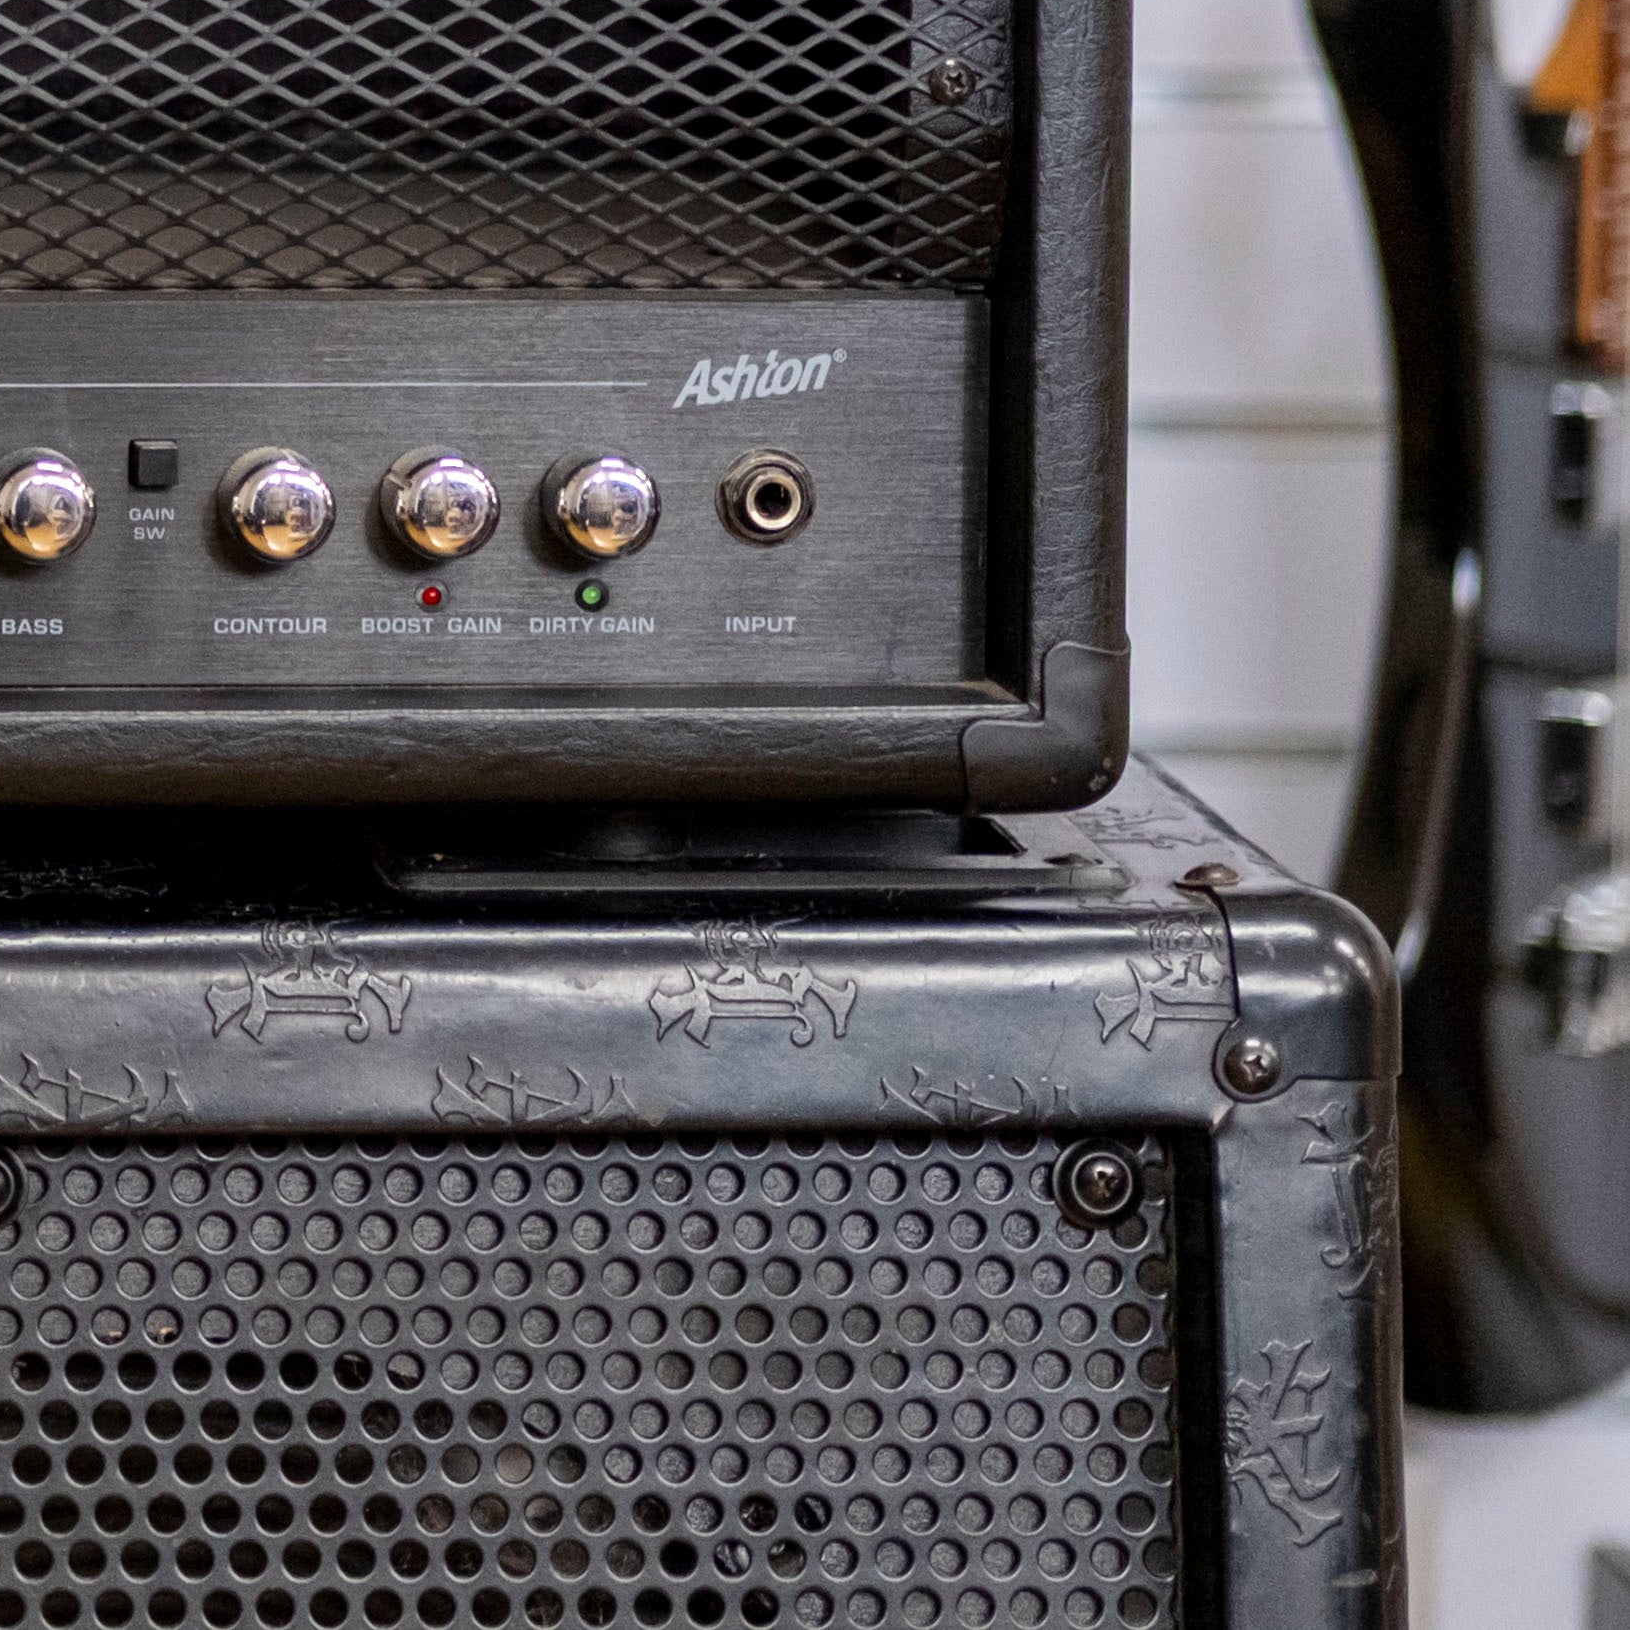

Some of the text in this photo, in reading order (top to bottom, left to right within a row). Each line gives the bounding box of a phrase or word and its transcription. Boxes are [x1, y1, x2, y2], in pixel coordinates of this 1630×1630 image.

[128, 507, 175, 523] GAIN
[133, 526, 166, 541] SW
[1, 618, 64, 636] BASS
[213, 617, 327, 635] CONTOUR
[361, 617, 502, 634] BOOST GAIN
[529, 616, 655, 634] DIRTY GAIN
[725, 616, 797, 634] INPUT
